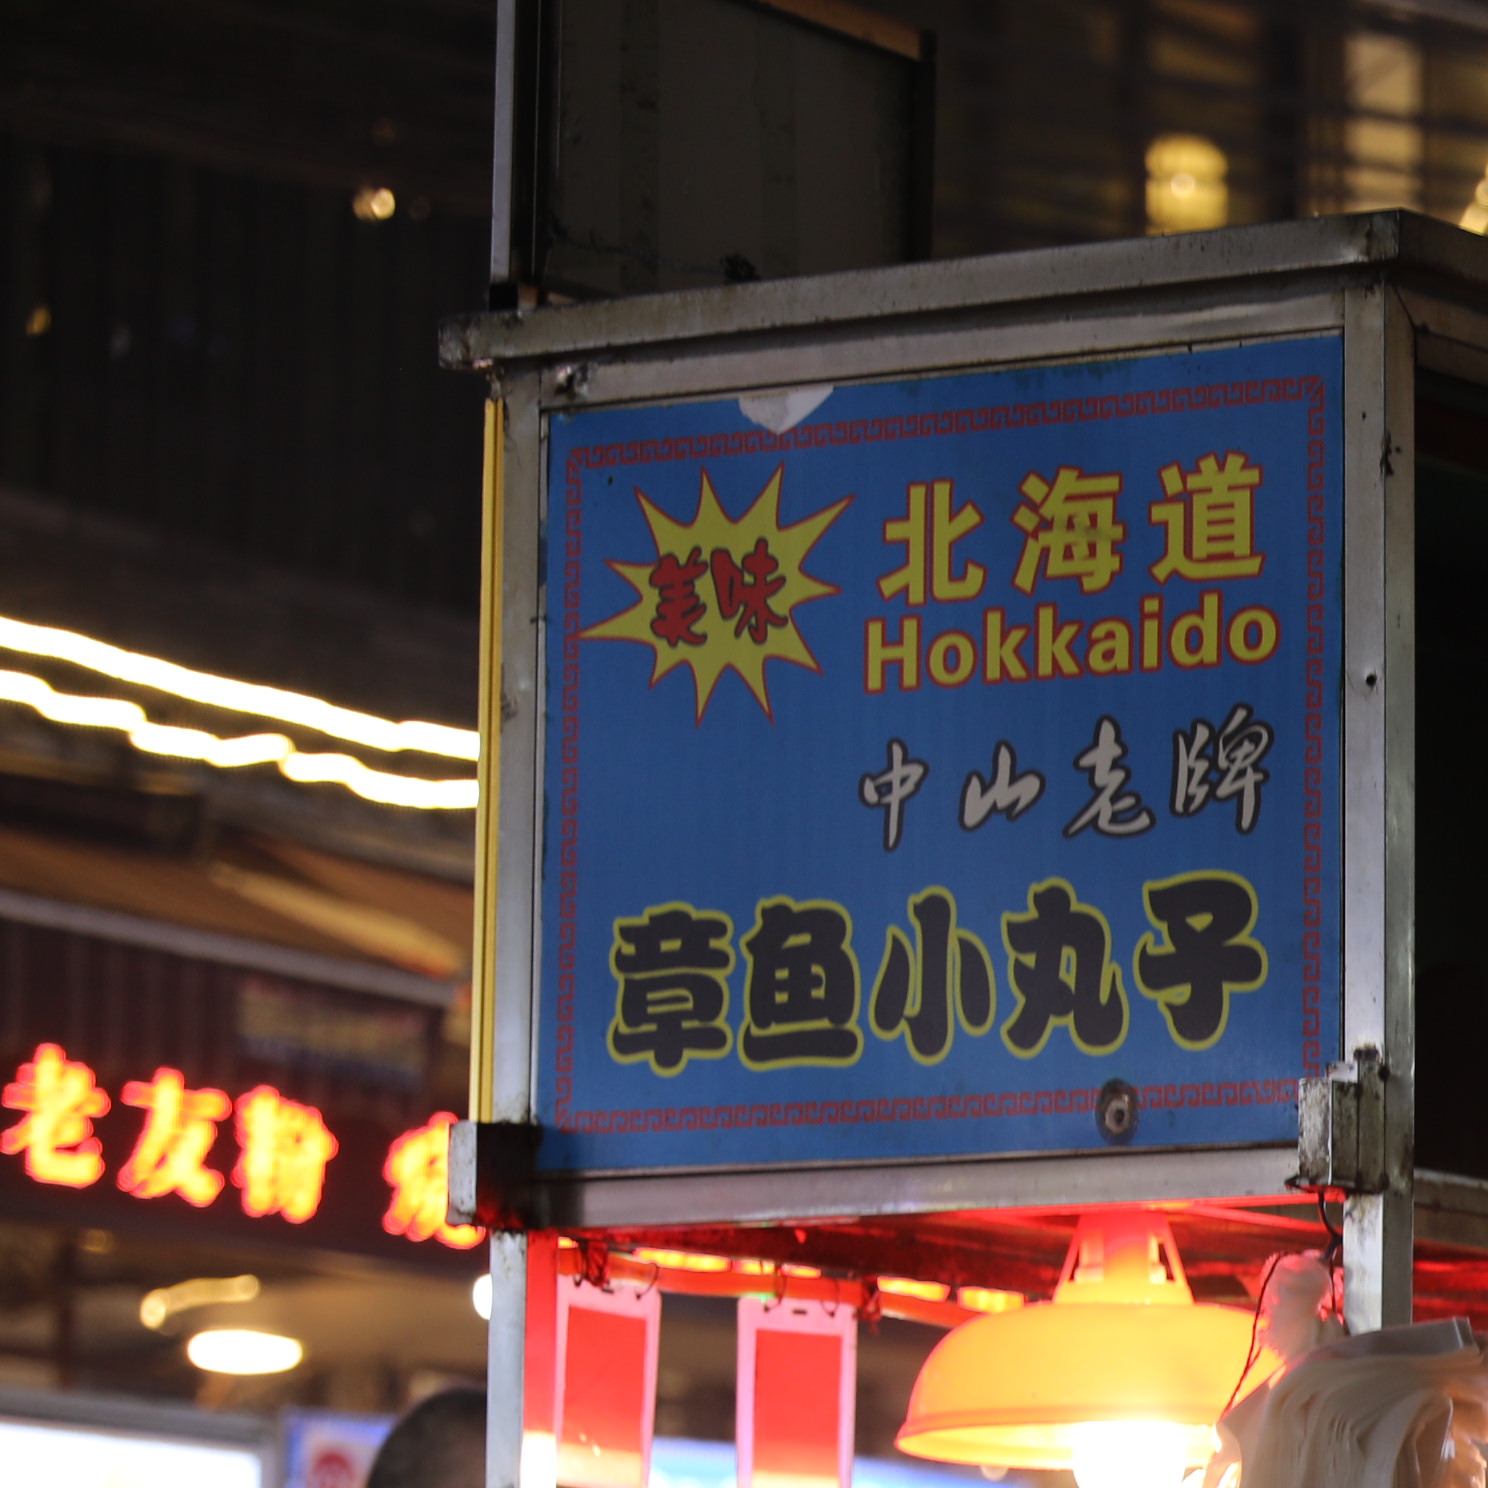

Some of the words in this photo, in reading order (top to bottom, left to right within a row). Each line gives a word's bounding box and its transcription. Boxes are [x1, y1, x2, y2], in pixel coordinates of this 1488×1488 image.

[649, 537, 788, 647] 美味
[880, 452, 1264, 605] 北海道
[862, 594, 1278, 693] Hokkaido
[859, 705, 1274, 852] 中山老牌
[608, 871, 1268, 1076] 章鱼小丸子
